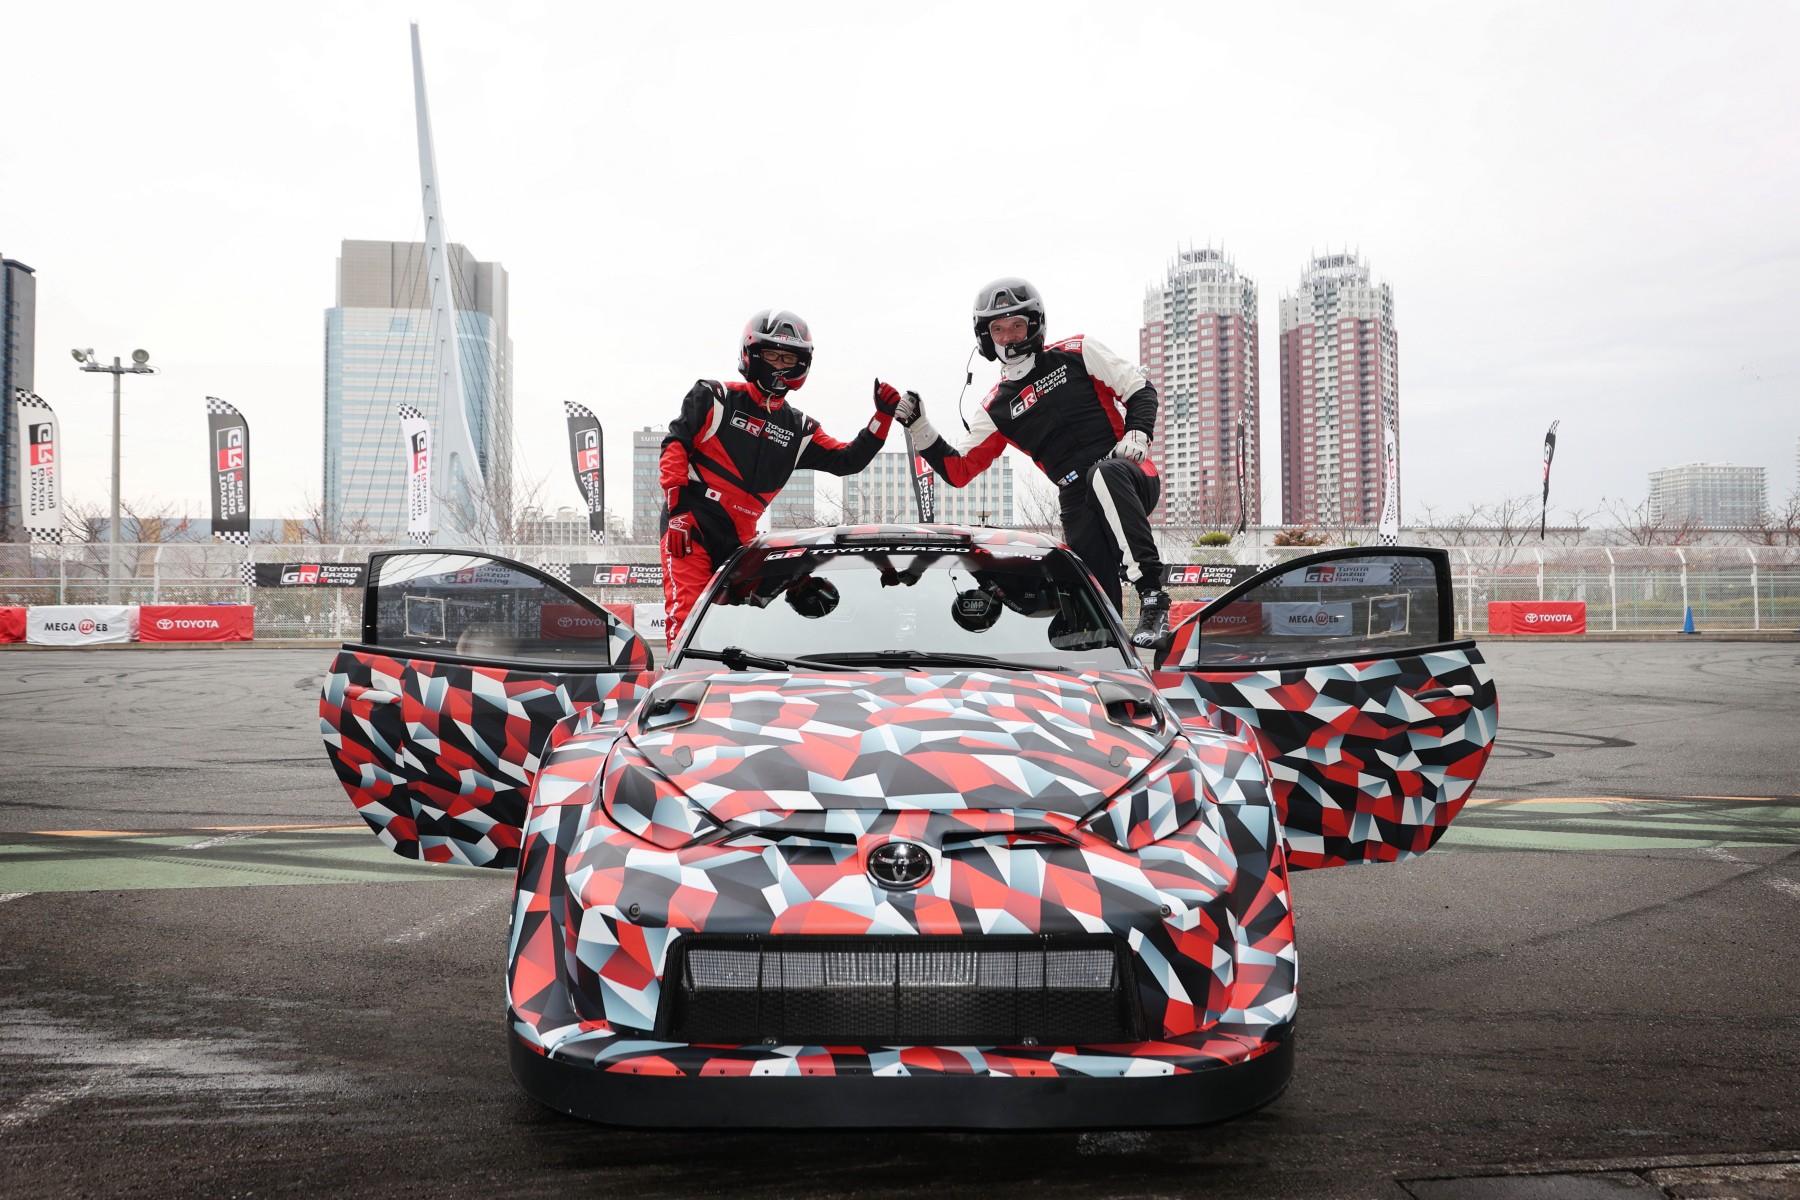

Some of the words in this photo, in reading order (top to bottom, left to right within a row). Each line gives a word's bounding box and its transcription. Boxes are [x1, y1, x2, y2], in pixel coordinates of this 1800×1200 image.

[1034, 364, 1068, 387] TOYOTA
[1036, 371, 1066, 393] GAZOO
[1037, 376, 1067, 398] Racing
[1012, 392, 1036, 416] GR
[732, 416, 760, 436] GR
[767, 421, 795, 437] TOYOTA
[765, 428, 791, 441] GAZOO
[809, 546, 890, 555] TOYOTA
[896, 545, 970, 553] GAZOO
[282, 572, 317, 583] GR
[319, 577, 356, 585] Racing
[595, 572, 626, 584] GR
[1169, 573, 1198, 583] GR
[962, 601, 984, 609] OMP
[575, 619, 606, 627] TOYO
[650, 619, 666, 628] ME
[1212, 615, 1248, 624] TOYOTA
[1288, 615, 1314, 623] MEGA
[1539, 614, 1573, 623] TOYOTA
[44, 622, 76, 632] MEGA
[175, 619, 219, 629] TOYOTA
